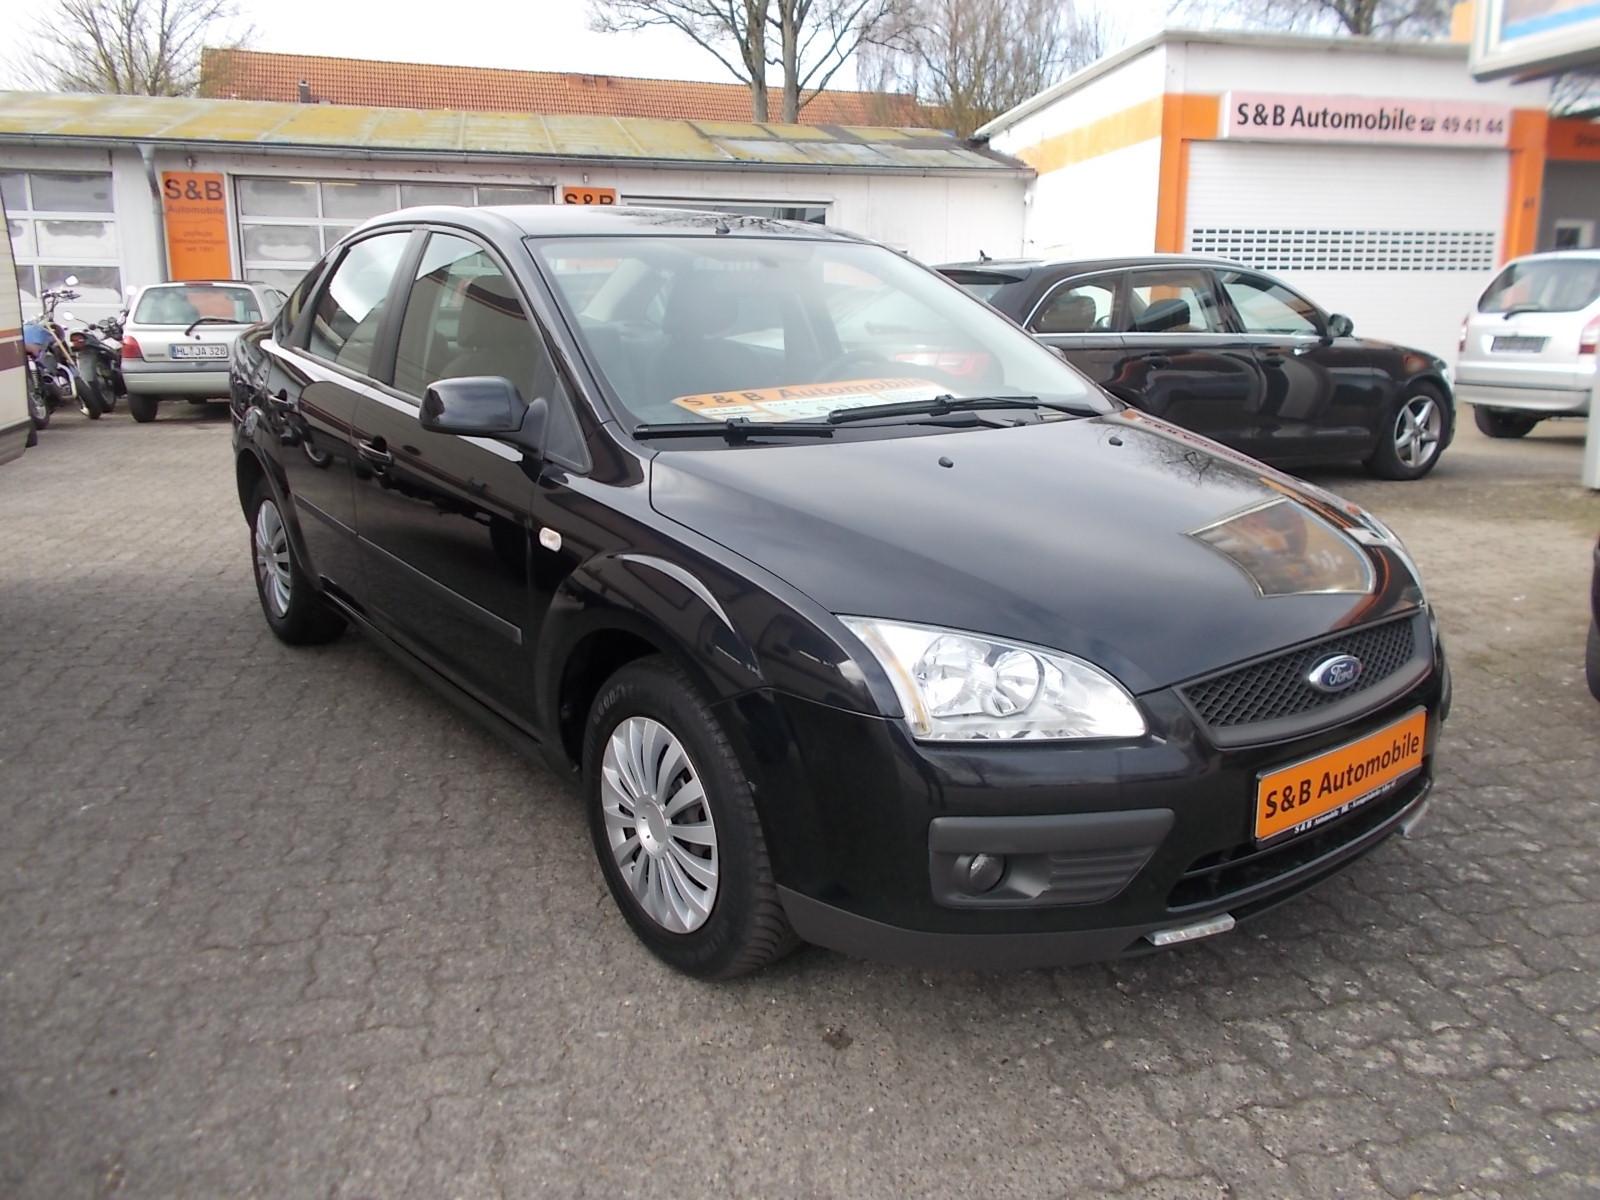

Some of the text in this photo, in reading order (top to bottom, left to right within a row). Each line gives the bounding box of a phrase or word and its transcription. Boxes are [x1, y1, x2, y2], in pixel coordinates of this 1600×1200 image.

[1291, 105, 1416, 132] Automobile
[1441, 116, 1459, 134] 49
[1463, 117, 1481, 134] 41
[1485, 118, 1504, 134] 44
[164, 178, 223, 201] S&B
[176, 346, 189, 356] HL
[682, 396, 705, 407] S
[713, 394, 736, 404] &
[741, 392, 765, 401] B
[1328, 663, 1354, 686] Ford
[1265, 778, 1313, 819] S&B
[1317, 732, 1419, 798] Automobile
